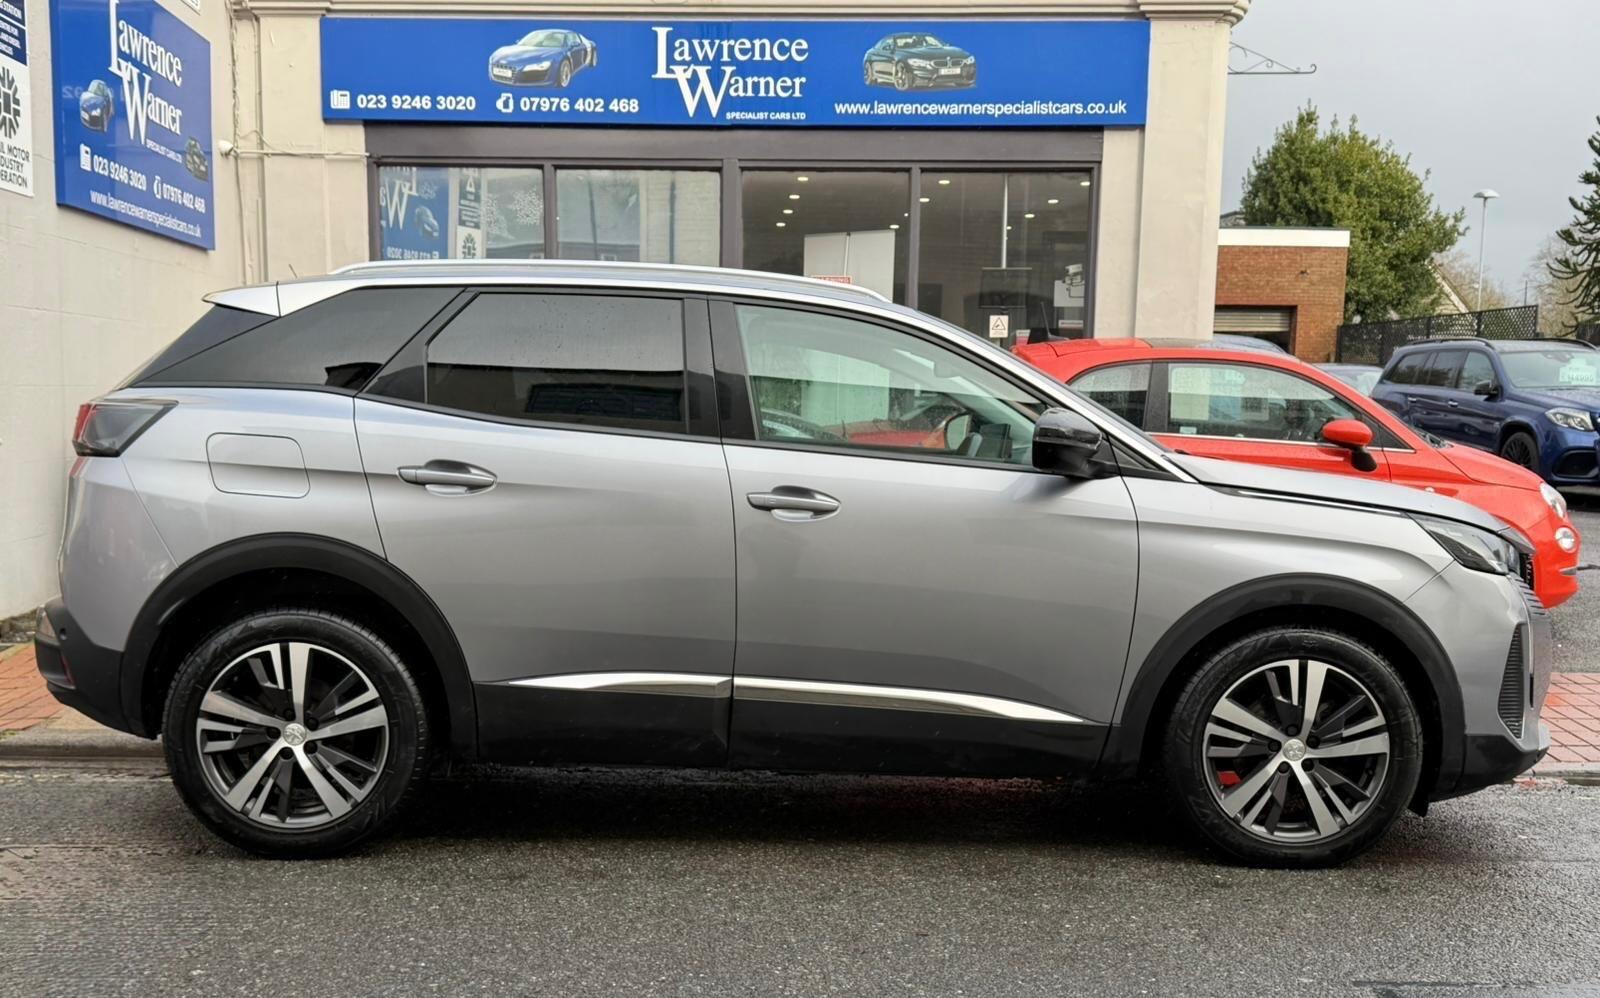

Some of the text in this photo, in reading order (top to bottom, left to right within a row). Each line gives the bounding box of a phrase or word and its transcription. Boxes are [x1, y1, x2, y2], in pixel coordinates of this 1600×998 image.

[108, 0, 182, 87] Lawrence
[651, 26, 808, 78] Lawrence
[671, 65, 806, 118] Warner
[118, 60, 182, 145] Warner
[357, 94, 476, 110] 023 9246 3020
[520, 96, 639, 113] 07976 402 468
[834, 99, 1126, 118] www.lawrencewarnerspecialistcars.co.uk
[726, 111, 806, 120] SPECIALIST CARS LTD
[7, 144, 30, 162] MOTOR
[0, 169, 28, 188] ERATION
[93, 154, 147, 191] 023 9246 3020
